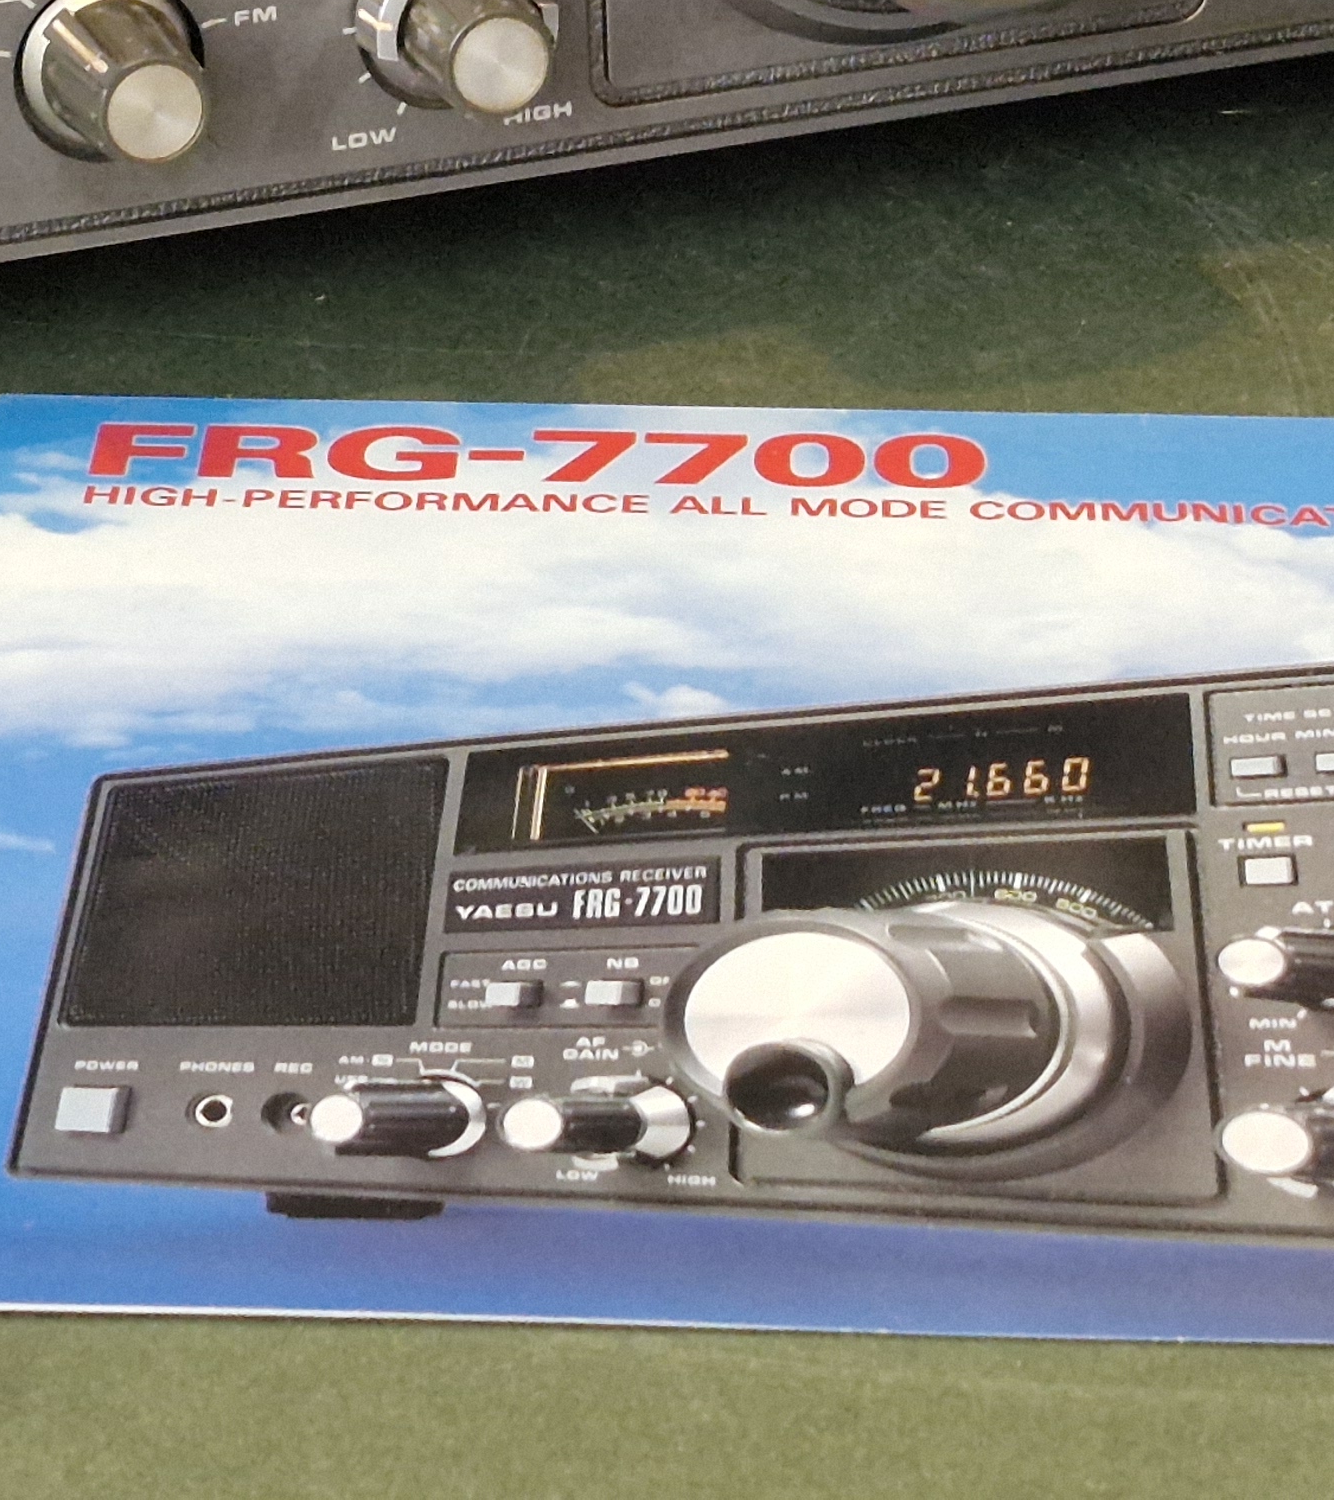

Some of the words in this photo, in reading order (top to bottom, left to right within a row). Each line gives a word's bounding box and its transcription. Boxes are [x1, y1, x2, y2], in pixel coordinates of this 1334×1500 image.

[234, 5, 277, 27] FM
[503, 101, 572, 125] HIGH
[331, 128, 397, 151] LOW
[87, 421, 987, 489] FRG-7700
[83, 483, 650, 517] HIGH-PERFORMANCE
[670, 493, 768, 517] ALL
[789, 496, 948, 522] MODE
[1243, 710, 1295, 722] TIME
[1223, 731, 1286, 744] HOUR
[1219, 834, 1313, 849] TIMER
[453, 869, 612, 892] COMMUNICATIONS
[620, 865, 707, 883] RECEIVER
[455, 902, 558, 920] YAESU
[1248, 1016, 1296, 1030] MIN
[1264, 1038, 1293, 1052] M
[74, 1060, 139, 1071] POWER
[179, 1060, 256, 1074] PHONES
[1244, 1051, 1315, 1068] FINE
[556, 1170, 598, 1181] LOW
